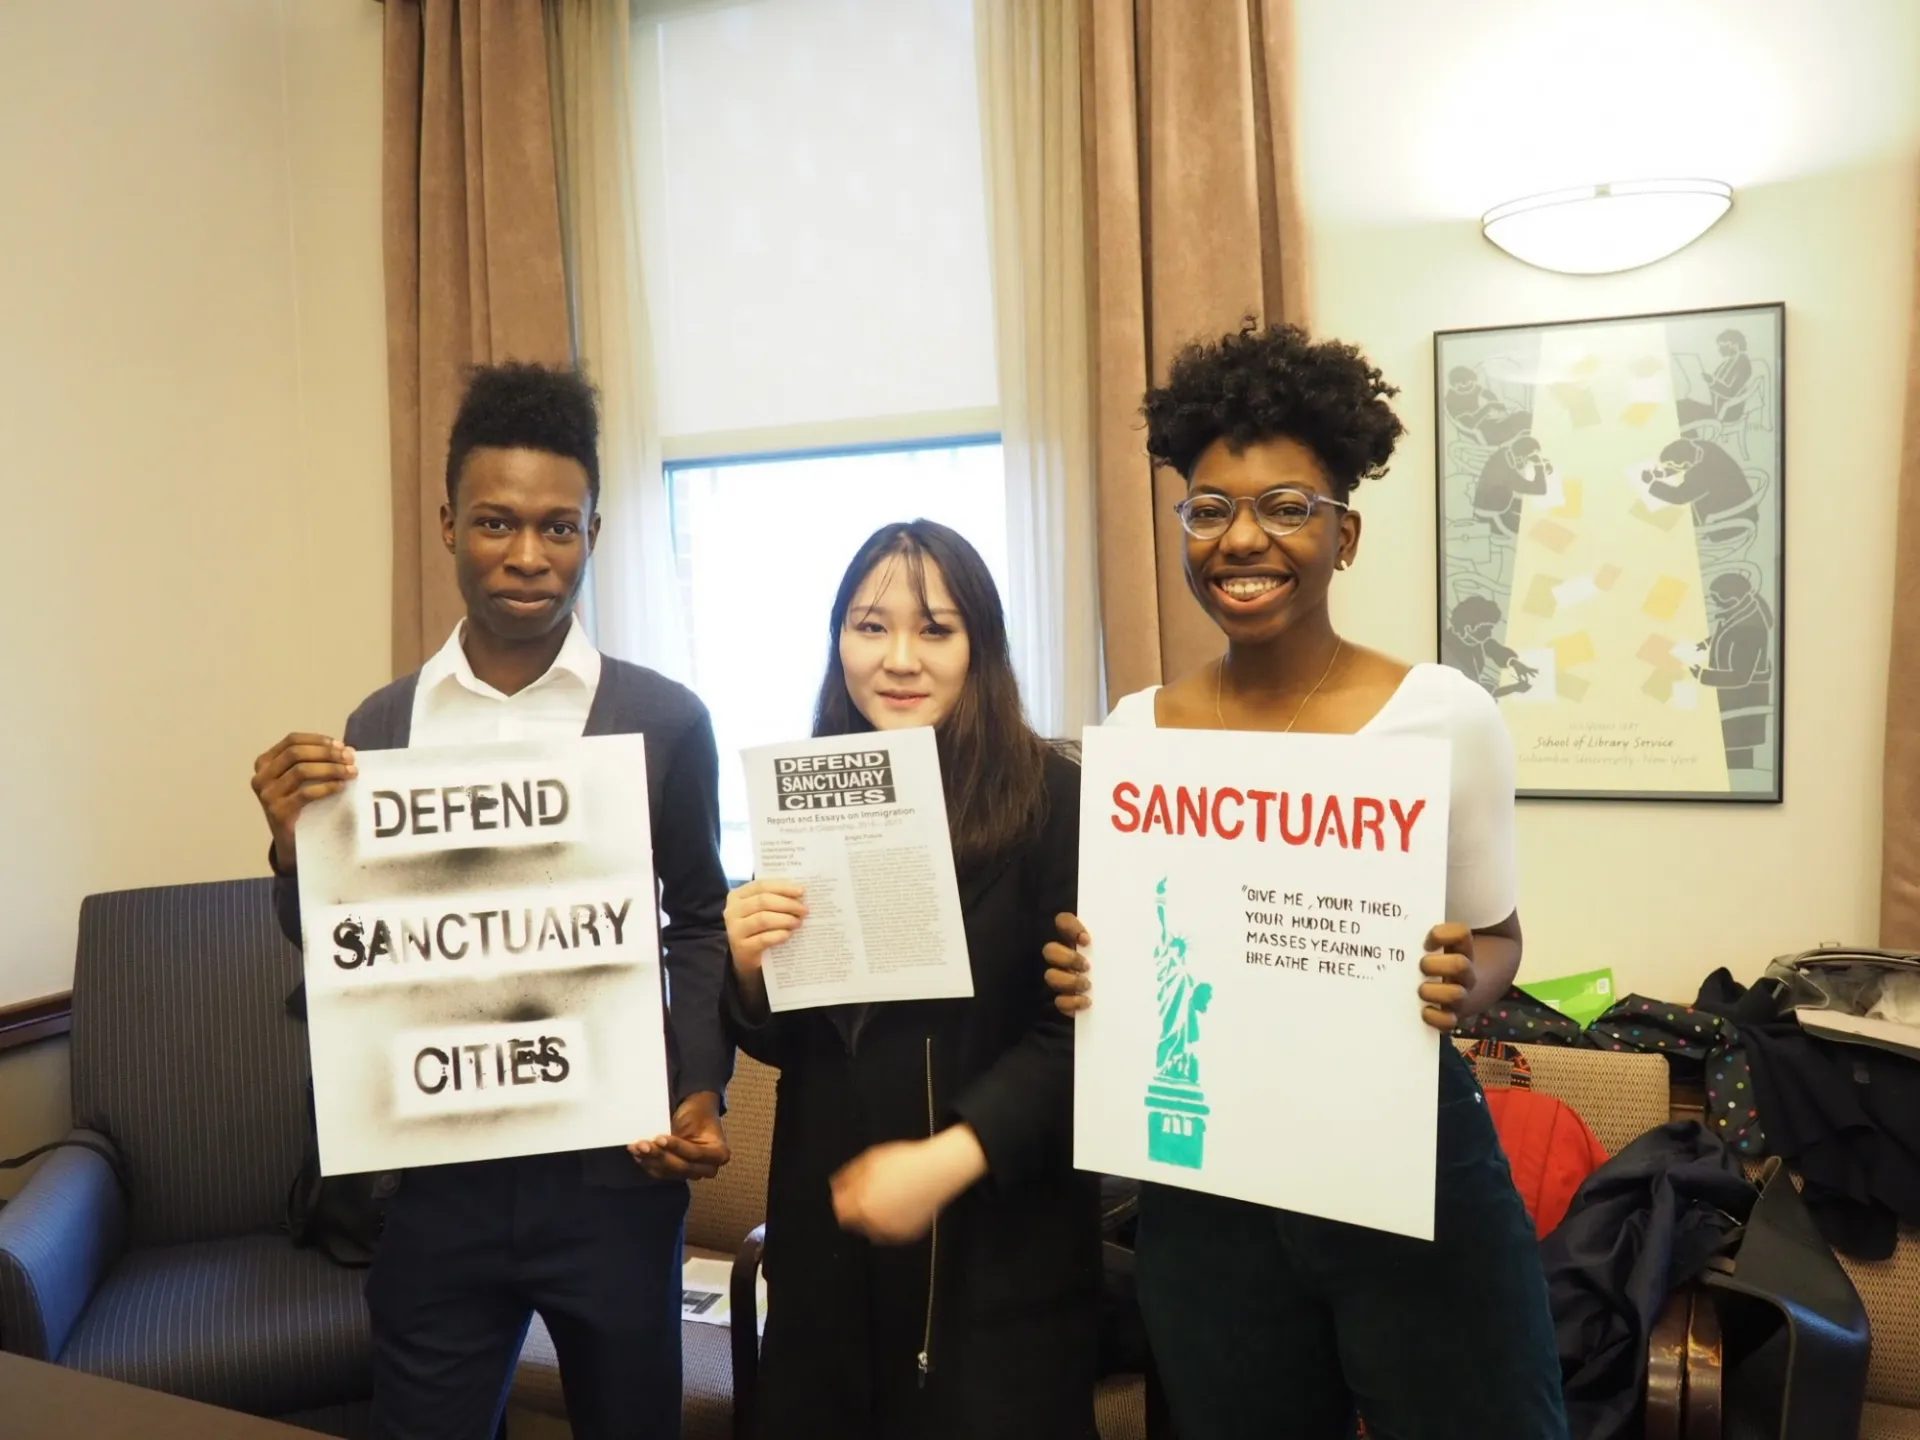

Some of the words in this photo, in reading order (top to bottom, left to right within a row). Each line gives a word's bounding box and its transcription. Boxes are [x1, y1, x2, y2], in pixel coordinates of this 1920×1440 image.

[1532, 735, 1570, 749] School
[1573, 734, 1587, 749] of
[1587, 736, 1630, 752] Library
[1633, 736, 1674, 749] Service
[779, 752, 884, 773] DEFEND
[781, 769, 885, 792] SANCTUARY
[372, 778, 571, 838] DEFEND
[785, 789, 886, 810] CITIES
[766, 816, 796, 827] Reports
[797, 815, 813, 823] and
[814, 813, 846, 823] Essays
[860, 807, 916, 819] Immigration
[1110, 780, 1426, 853] SANCTUARY
[1316, 895, 1353, 912] YOUR
[1360, 899, 1409, 920] TIRED,
[332, 898, 634, 970] SANCTUARY
[1245, 910, 1284, 926] YOUR
[1291, 915, 1361, 935] HUDDLED
[1246, 930, 1307, 950] MASSES
[1310, 938, 1382, 960] YEARNING
[1388, 947, 1405, 962] TO
[1245, 950, 1309, 972] BREATHE
[413, 1036, 570, 1095] CITIES
